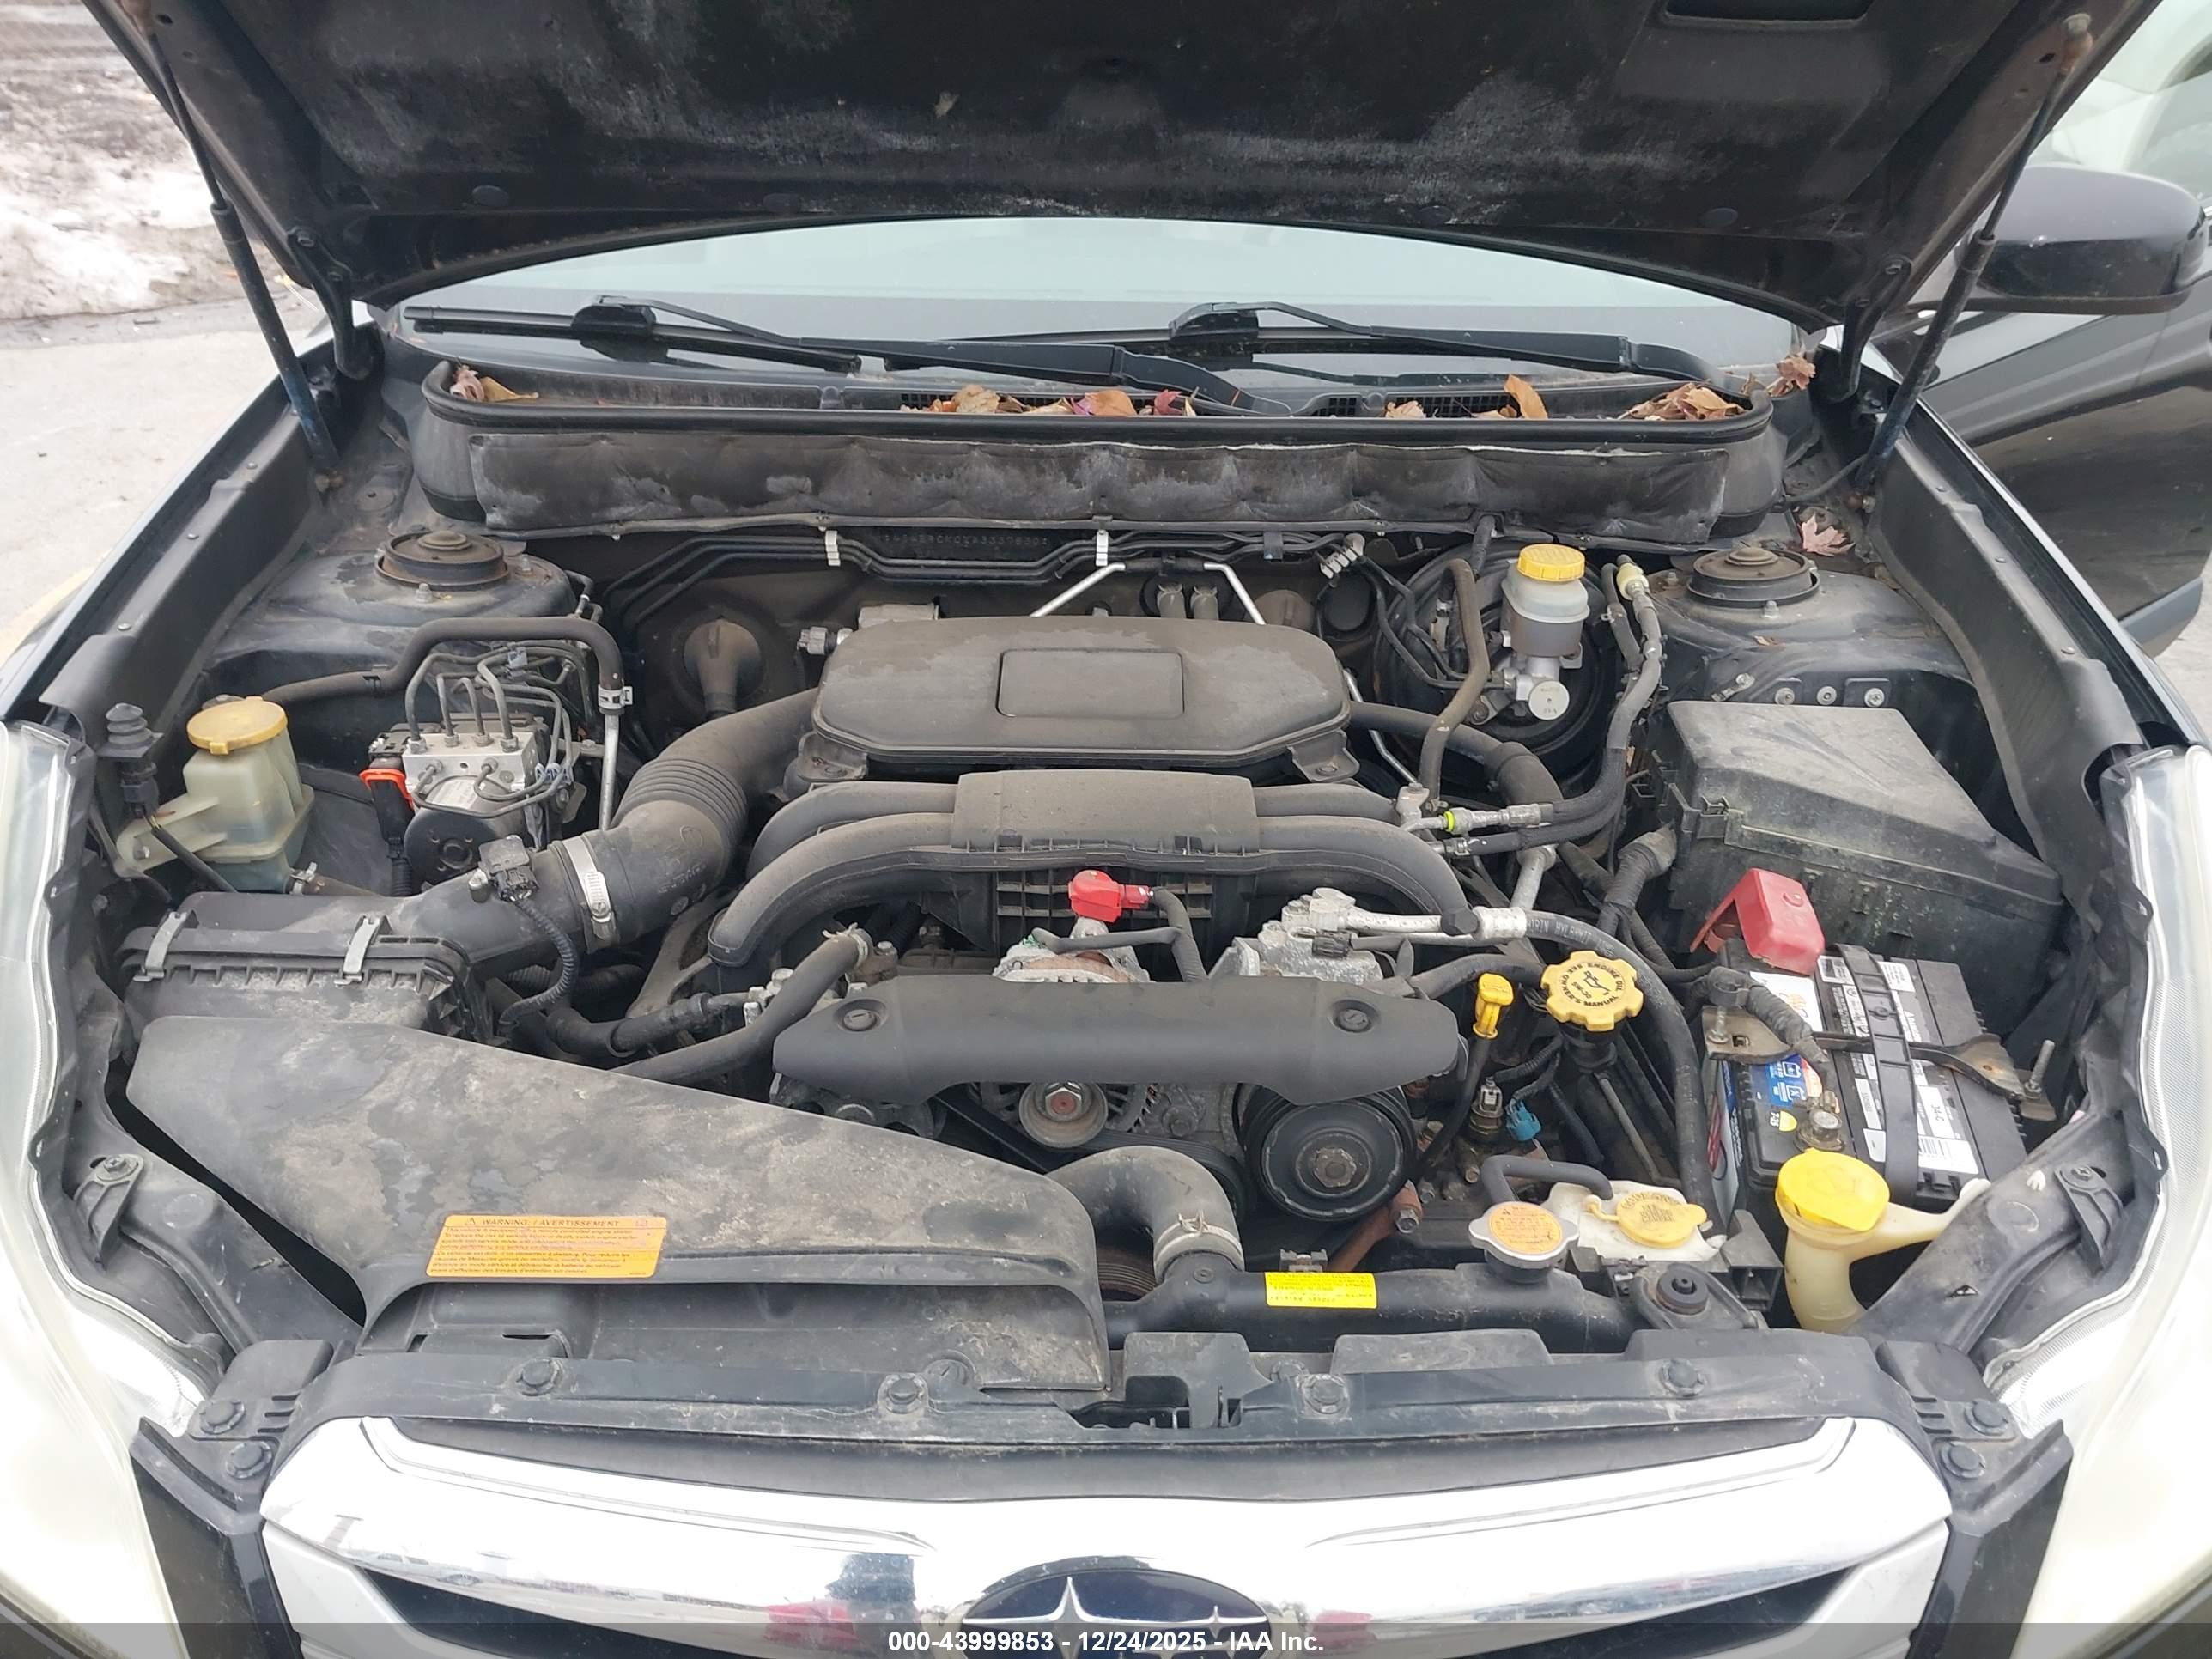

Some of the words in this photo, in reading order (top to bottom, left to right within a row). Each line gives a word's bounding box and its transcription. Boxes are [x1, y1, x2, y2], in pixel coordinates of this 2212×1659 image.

[1567, 963, 1583, 975] SEE
[1583, 995, 1620, 1007] MANUAL
[1587, 963, 1620, 979] ENGINE
[1615, 981, 1624, 991] OIL
